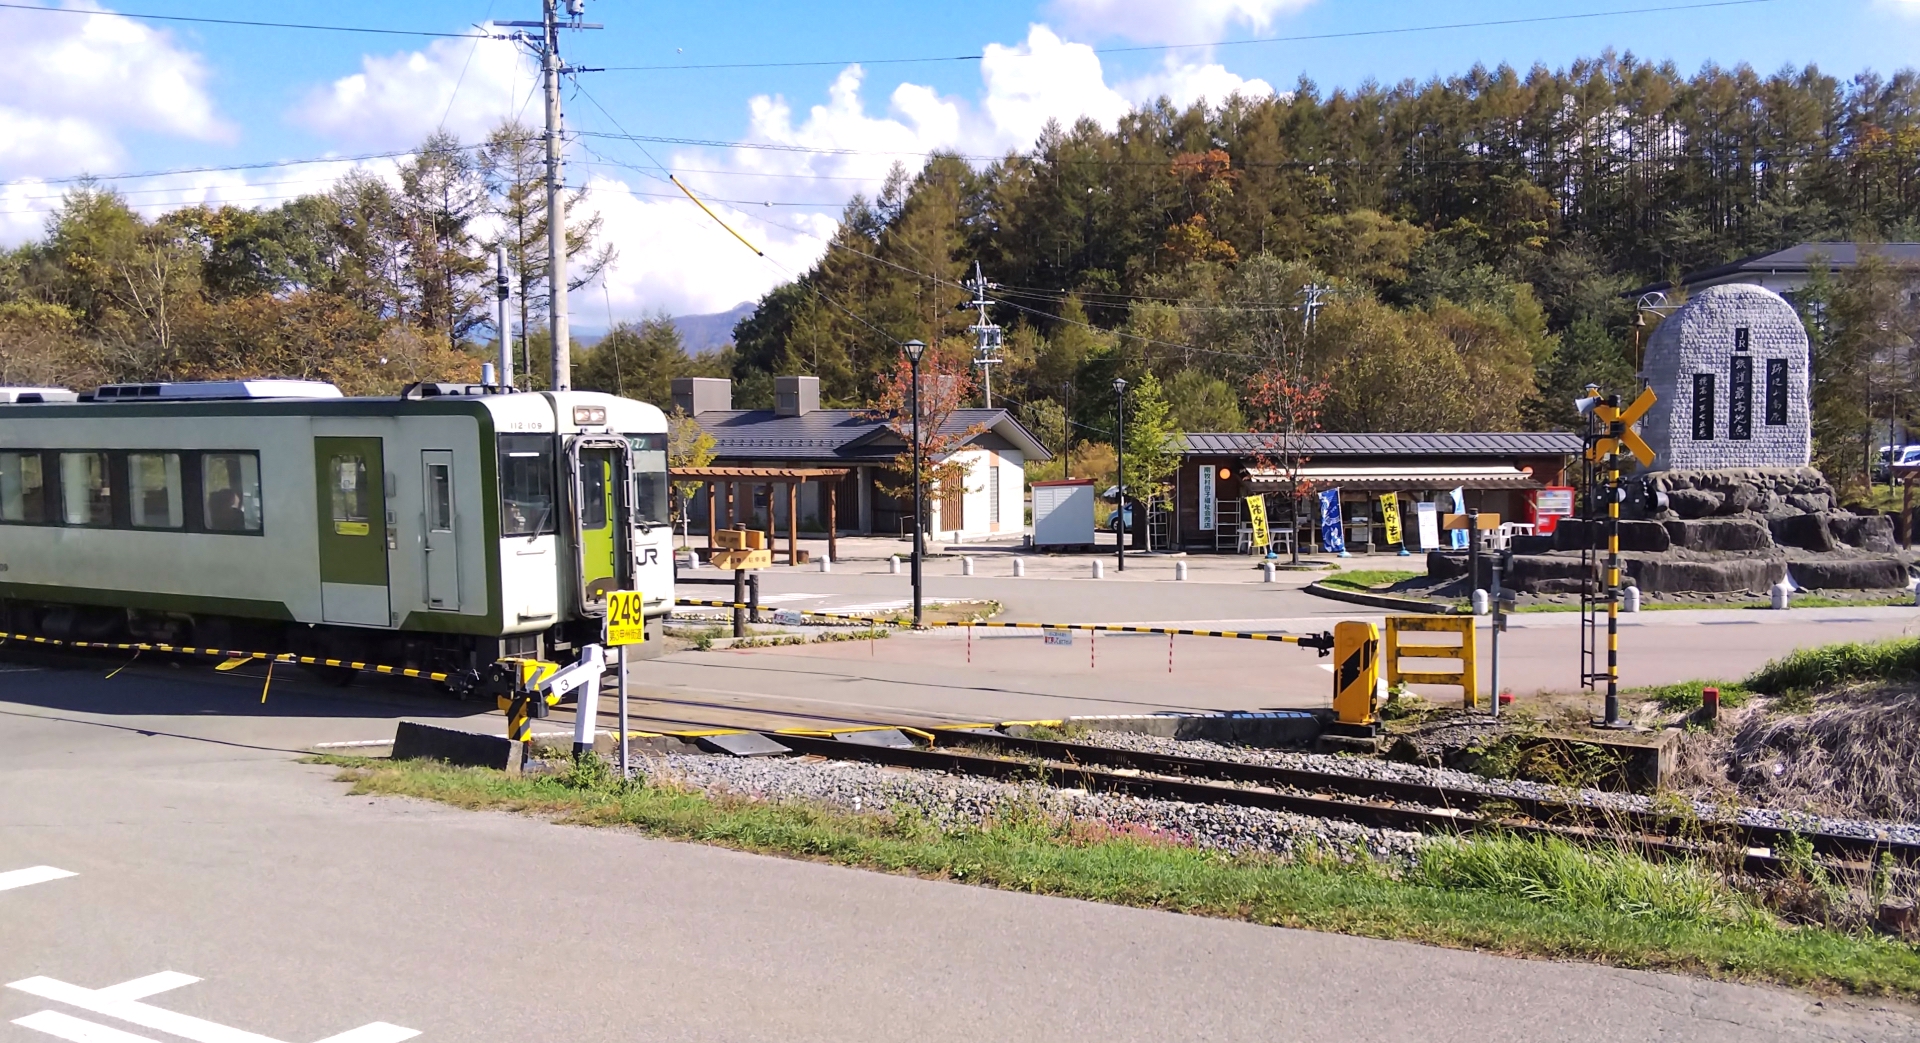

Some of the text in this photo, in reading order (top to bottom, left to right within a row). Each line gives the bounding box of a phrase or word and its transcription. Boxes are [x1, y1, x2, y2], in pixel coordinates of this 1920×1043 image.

[1251, 504, 1264, 539] おやき
[1384, 502, 1398, 536] おやき
[636, 548, 658, 567] JR
[609, 594, 642, 626] 249
[560, 679, 570, 691] 3
